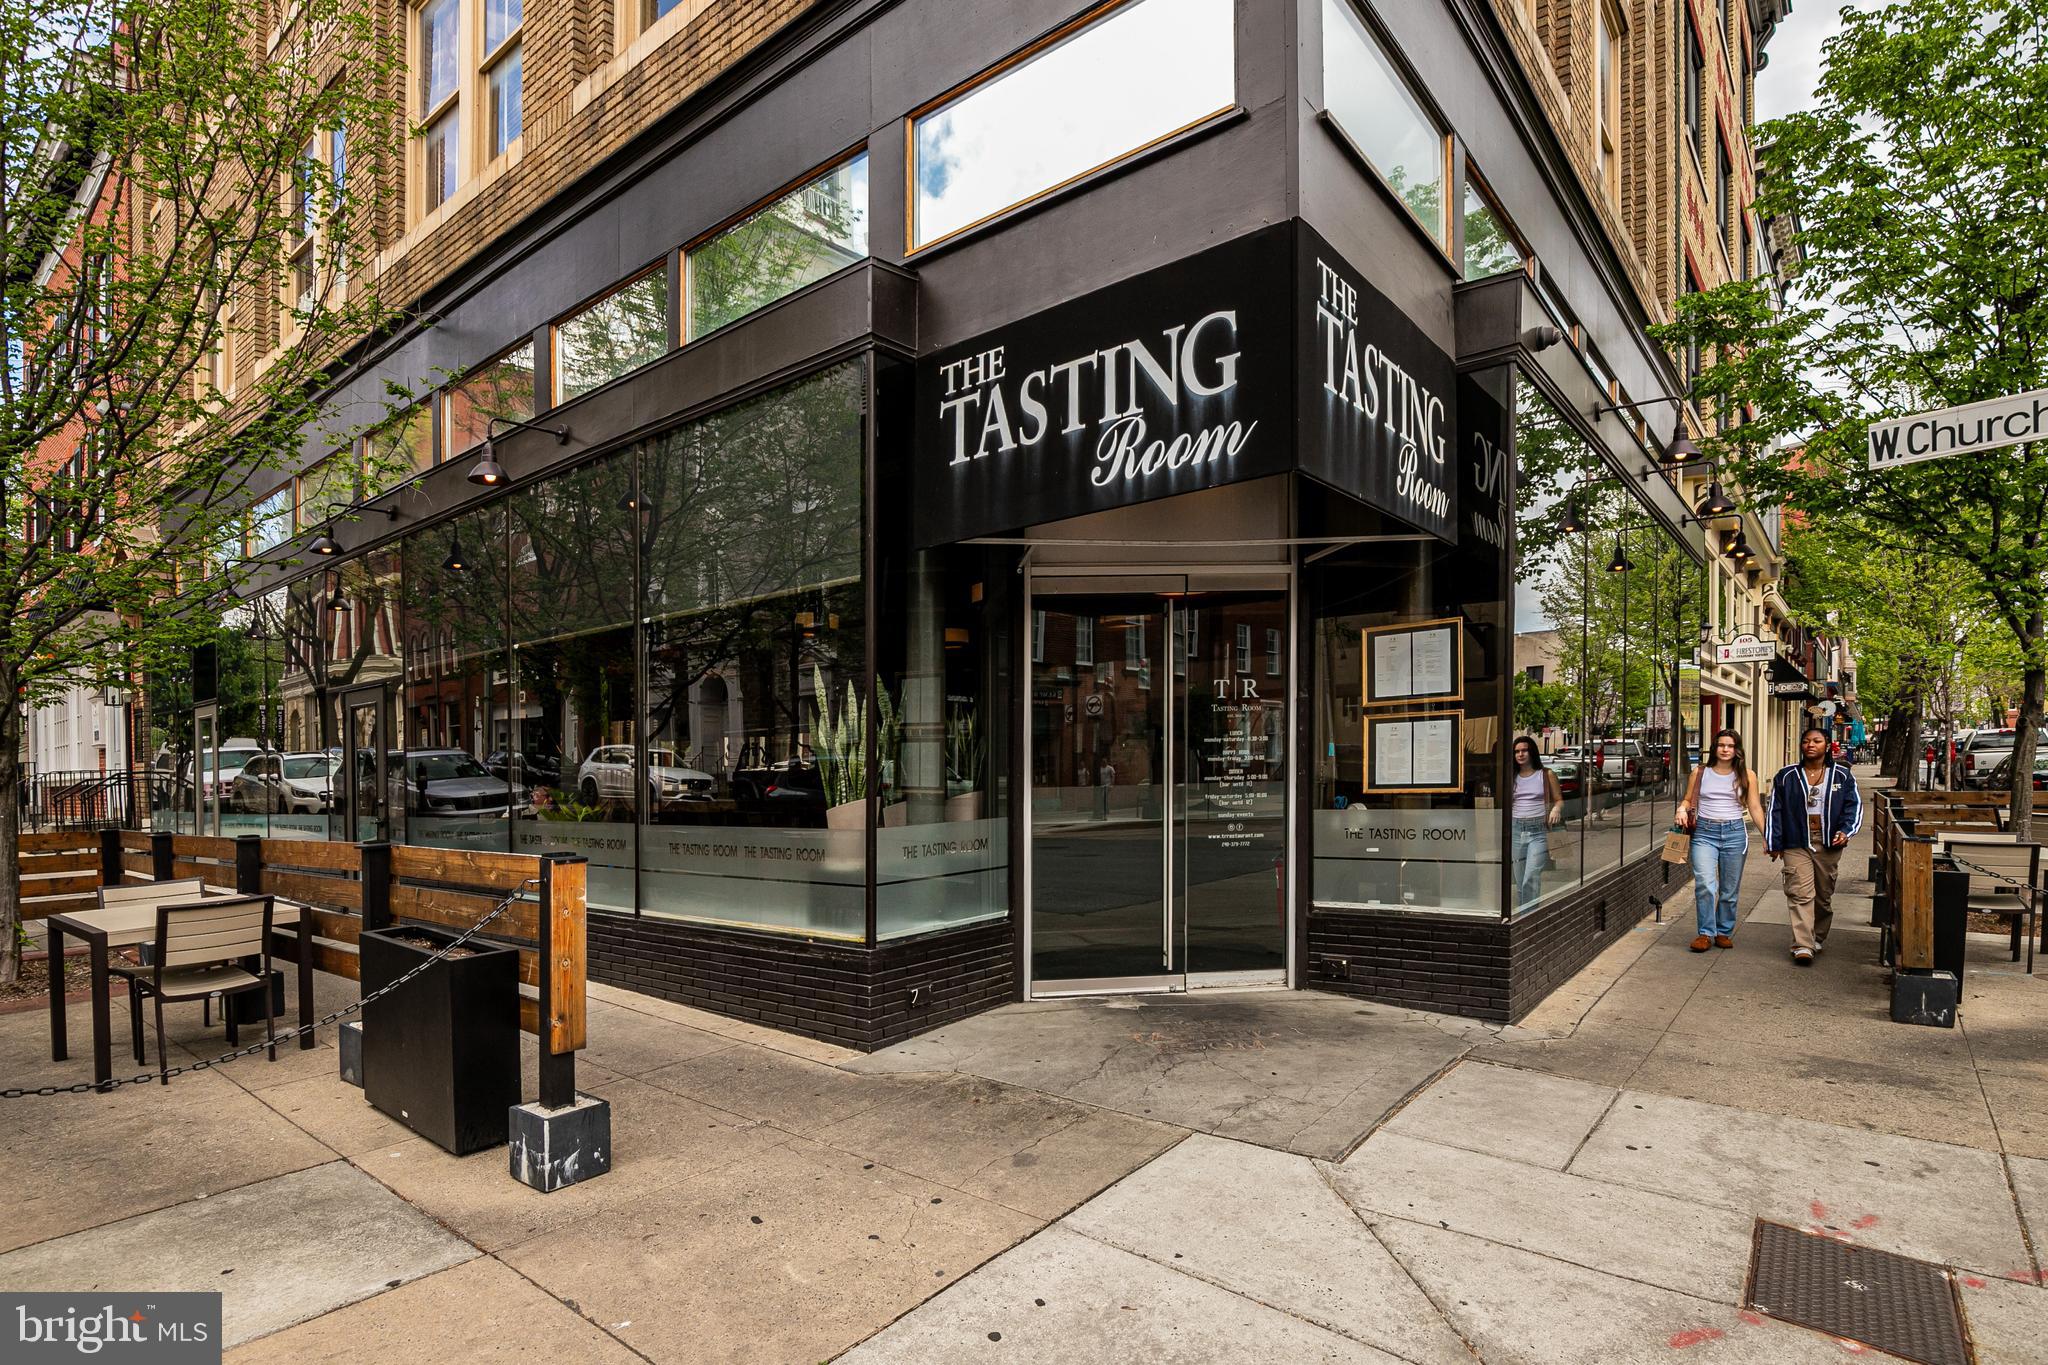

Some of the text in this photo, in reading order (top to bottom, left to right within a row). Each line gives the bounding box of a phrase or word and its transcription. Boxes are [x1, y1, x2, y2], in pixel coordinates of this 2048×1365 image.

[1316, 257, 1358, 326] THE
[940, 346, 1006, 396] THE
[940, 310, 1242, 466] TASTING
[1316, 300, 1446, 464] TASTING
[1091, 414, 1258, 486] Room
[1397, 442, 1450, 518] Room
[1736, 646, 1773, 654] FIRESTONE'S
[582, 837, 604, 848] TASTING
[607, 839, 626, 850] ROOM
[669, 843, 825, 862] THE TASTING ROOM THE TASTING ROOM
[902, 838, 988, 859] THE TASTING ROOM
[1344, 828, 1466, 840] THE TASTING ROOM
